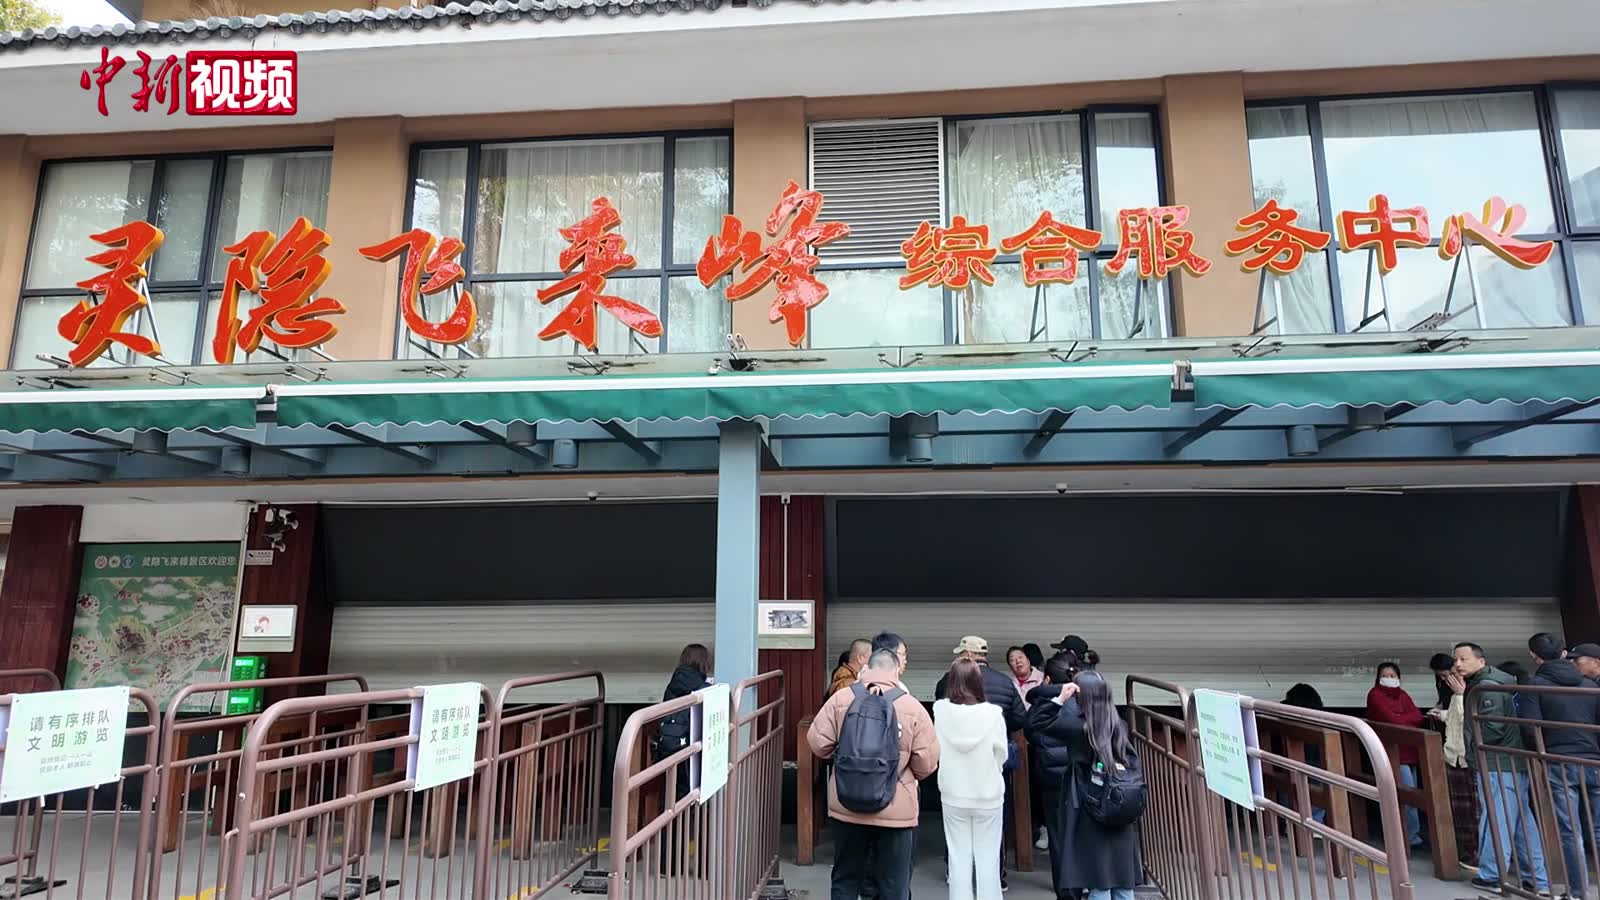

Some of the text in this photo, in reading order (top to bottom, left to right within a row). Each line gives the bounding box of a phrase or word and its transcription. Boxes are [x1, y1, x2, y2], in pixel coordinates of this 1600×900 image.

[29, 709, 110, 733] 请有序排队
[27, 727, 110, 752] 文明游览
